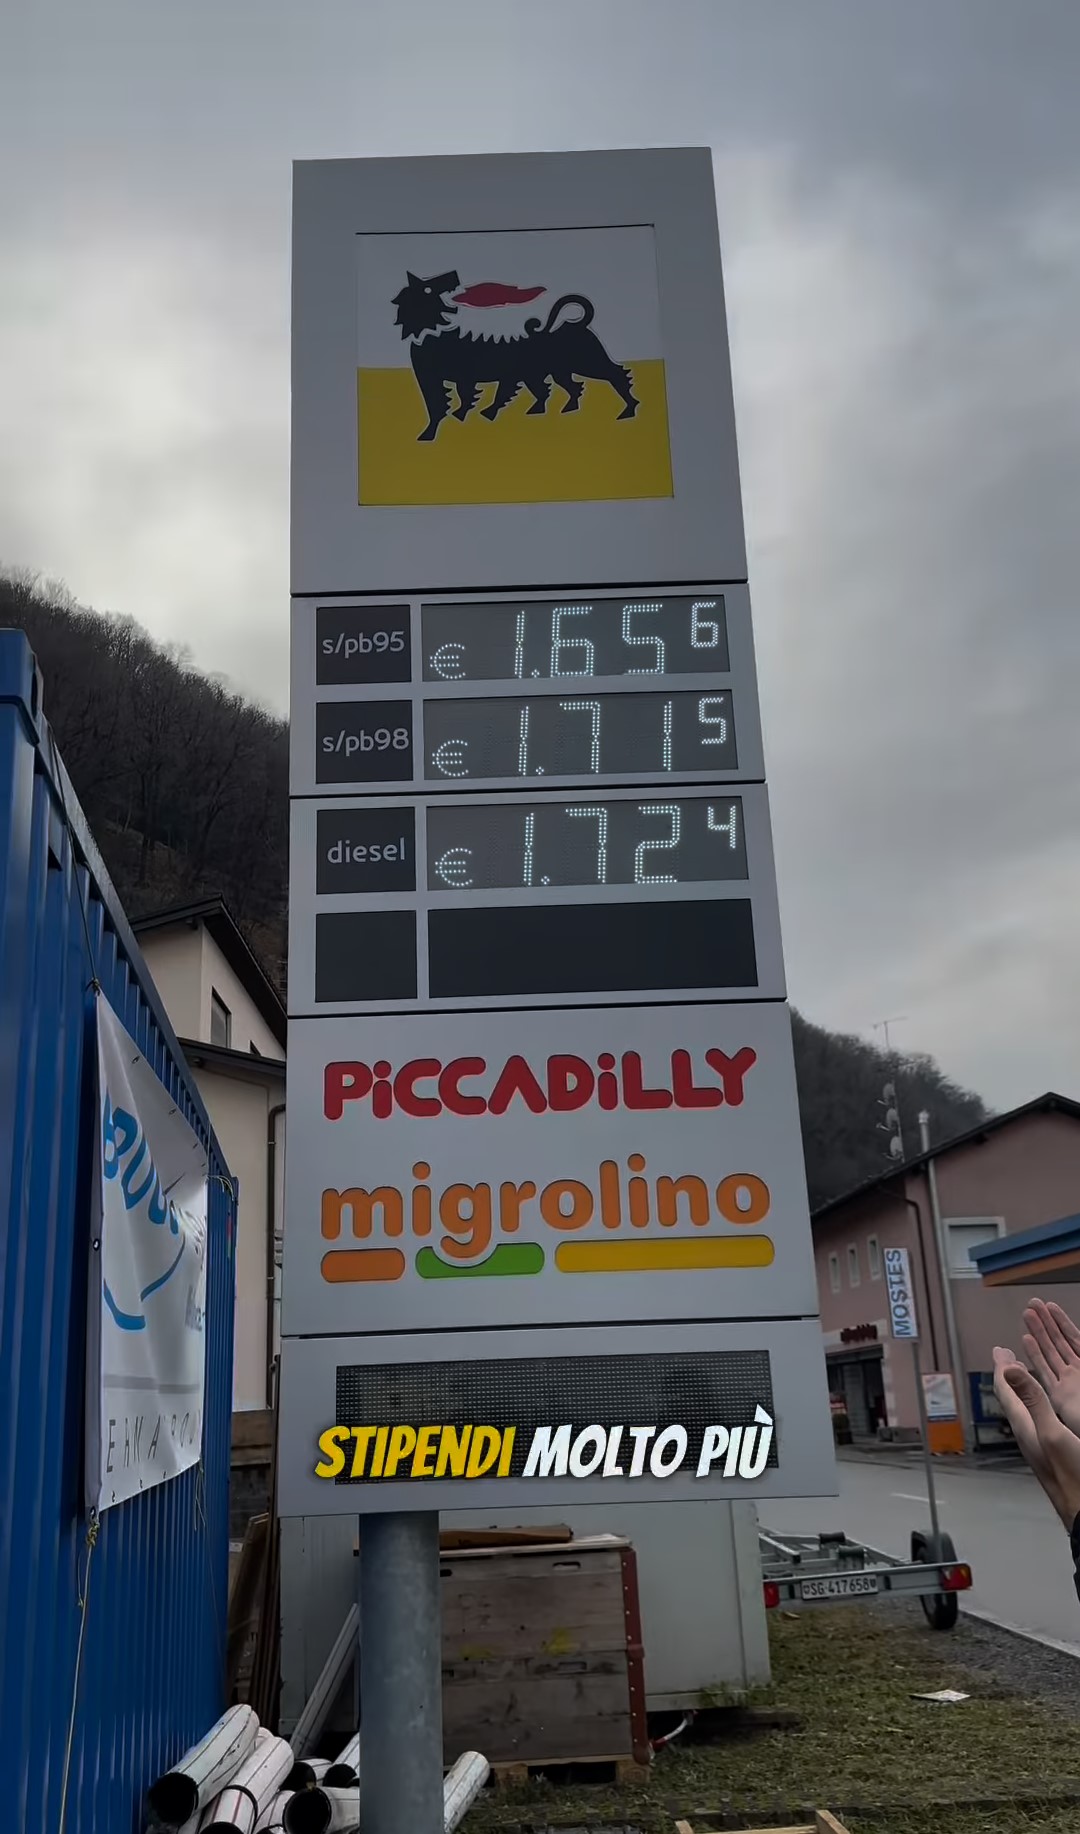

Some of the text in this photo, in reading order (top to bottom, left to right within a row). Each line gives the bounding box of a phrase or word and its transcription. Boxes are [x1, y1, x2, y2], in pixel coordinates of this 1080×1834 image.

[322, 630, 405, 659] s/pb95
[430, 643, 466, 679] €
[322, 727, 409, 756] s/pb98
[432, 740, 469, 776] €
[326, 837, 406, 864] diesel
[435, 847, 473, 886] €
[320, 1153, 770, 1259] migrolino
